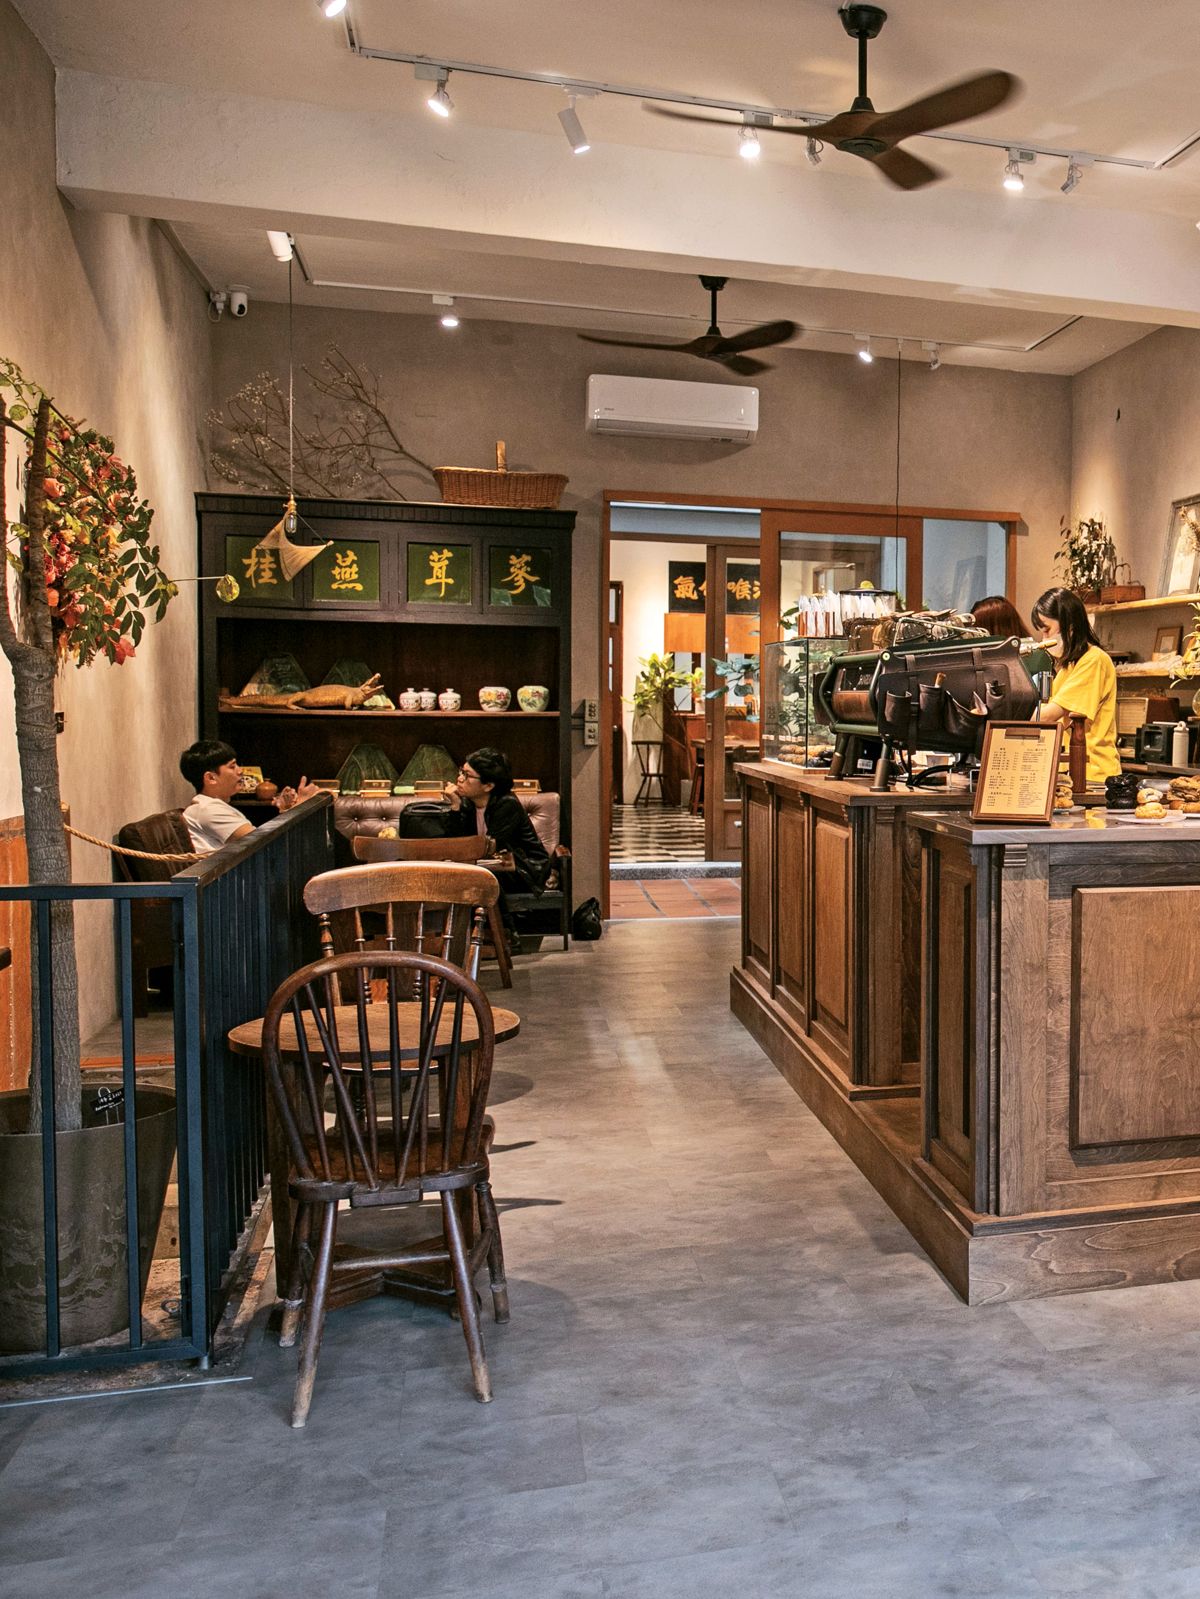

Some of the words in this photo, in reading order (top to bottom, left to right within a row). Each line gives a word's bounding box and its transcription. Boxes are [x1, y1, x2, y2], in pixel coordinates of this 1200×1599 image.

[241, 549, 278, 589] 桂
[330, 550, 364, 592] 燕
[424, 548, 455, 598] 茸
